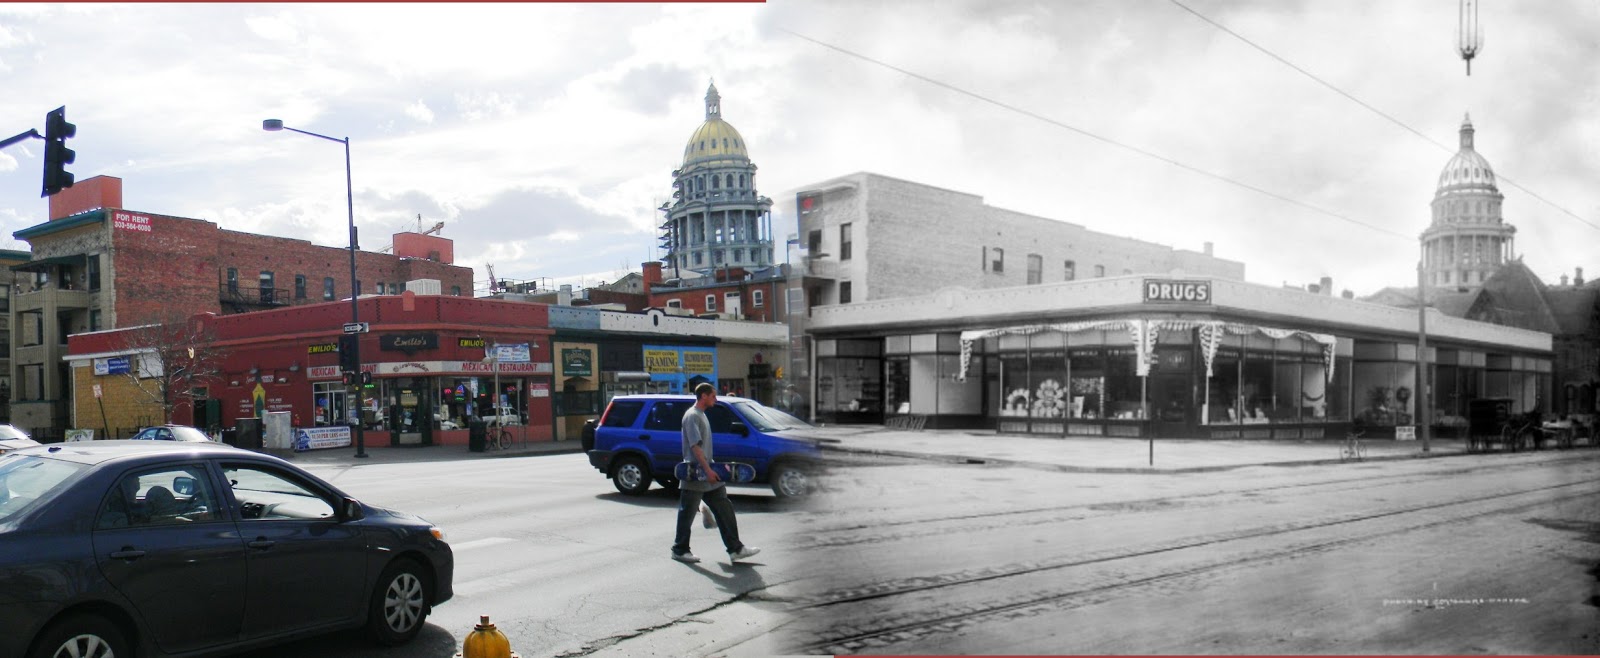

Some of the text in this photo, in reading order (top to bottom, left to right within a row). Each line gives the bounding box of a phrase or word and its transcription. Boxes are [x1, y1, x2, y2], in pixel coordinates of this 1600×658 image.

[116, 213, 149, 224] FOR RENT
[1148, 283, 1207, 300] DRUGS
[308, 342, 337, 353] EMILIO'S
[460, 339, 484, 347] EMILIO'S
[645, 356, 678, 368] FRAMING
[311, 367, 336, 376] MEXICAN
[499, 364, 538, 372] RESTAURANT
